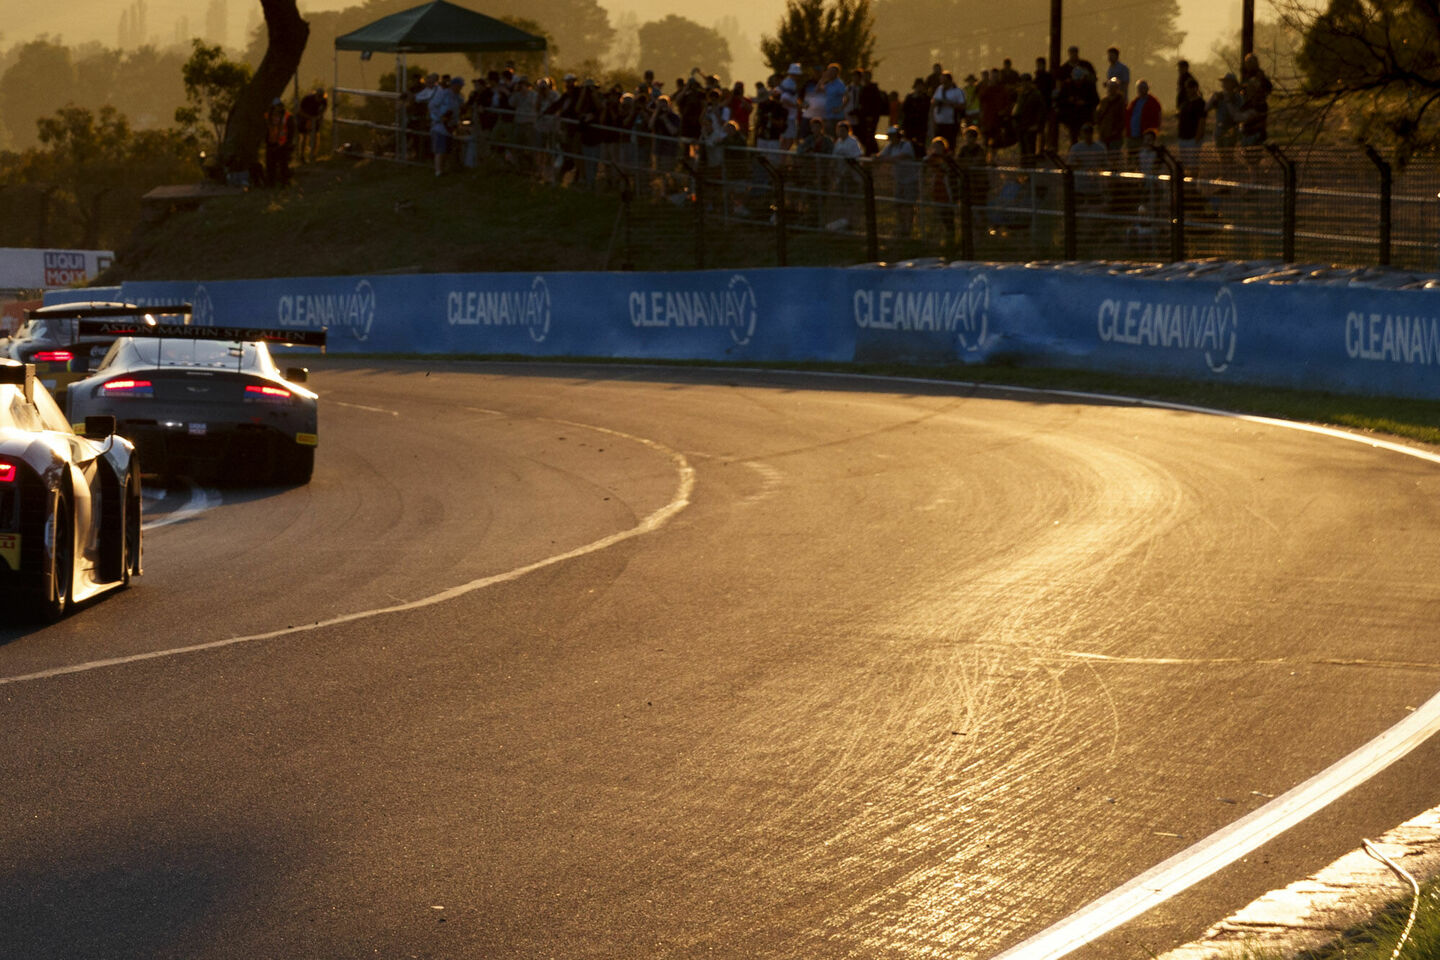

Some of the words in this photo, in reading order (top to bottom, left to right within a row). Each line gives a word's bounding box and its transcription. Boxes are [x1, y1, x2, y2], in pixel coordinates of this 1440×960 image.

[46, 254, 84, 269] LIQUI
[47, 271, 86, 286] MOLY
[278, 293, 368, 327] CLEANAWAY
[448, 290, 549, 326] CLEANAWAY
[629, 290, 747, 328] CLEANAWAY
[854, 288, 988, 330] CLEANAWAY
[1098, 299, 1231, 349] CLEANAWAY
[101, 323, 153, 336] ASTON
[160, 326, 218, 337] MARTIN
